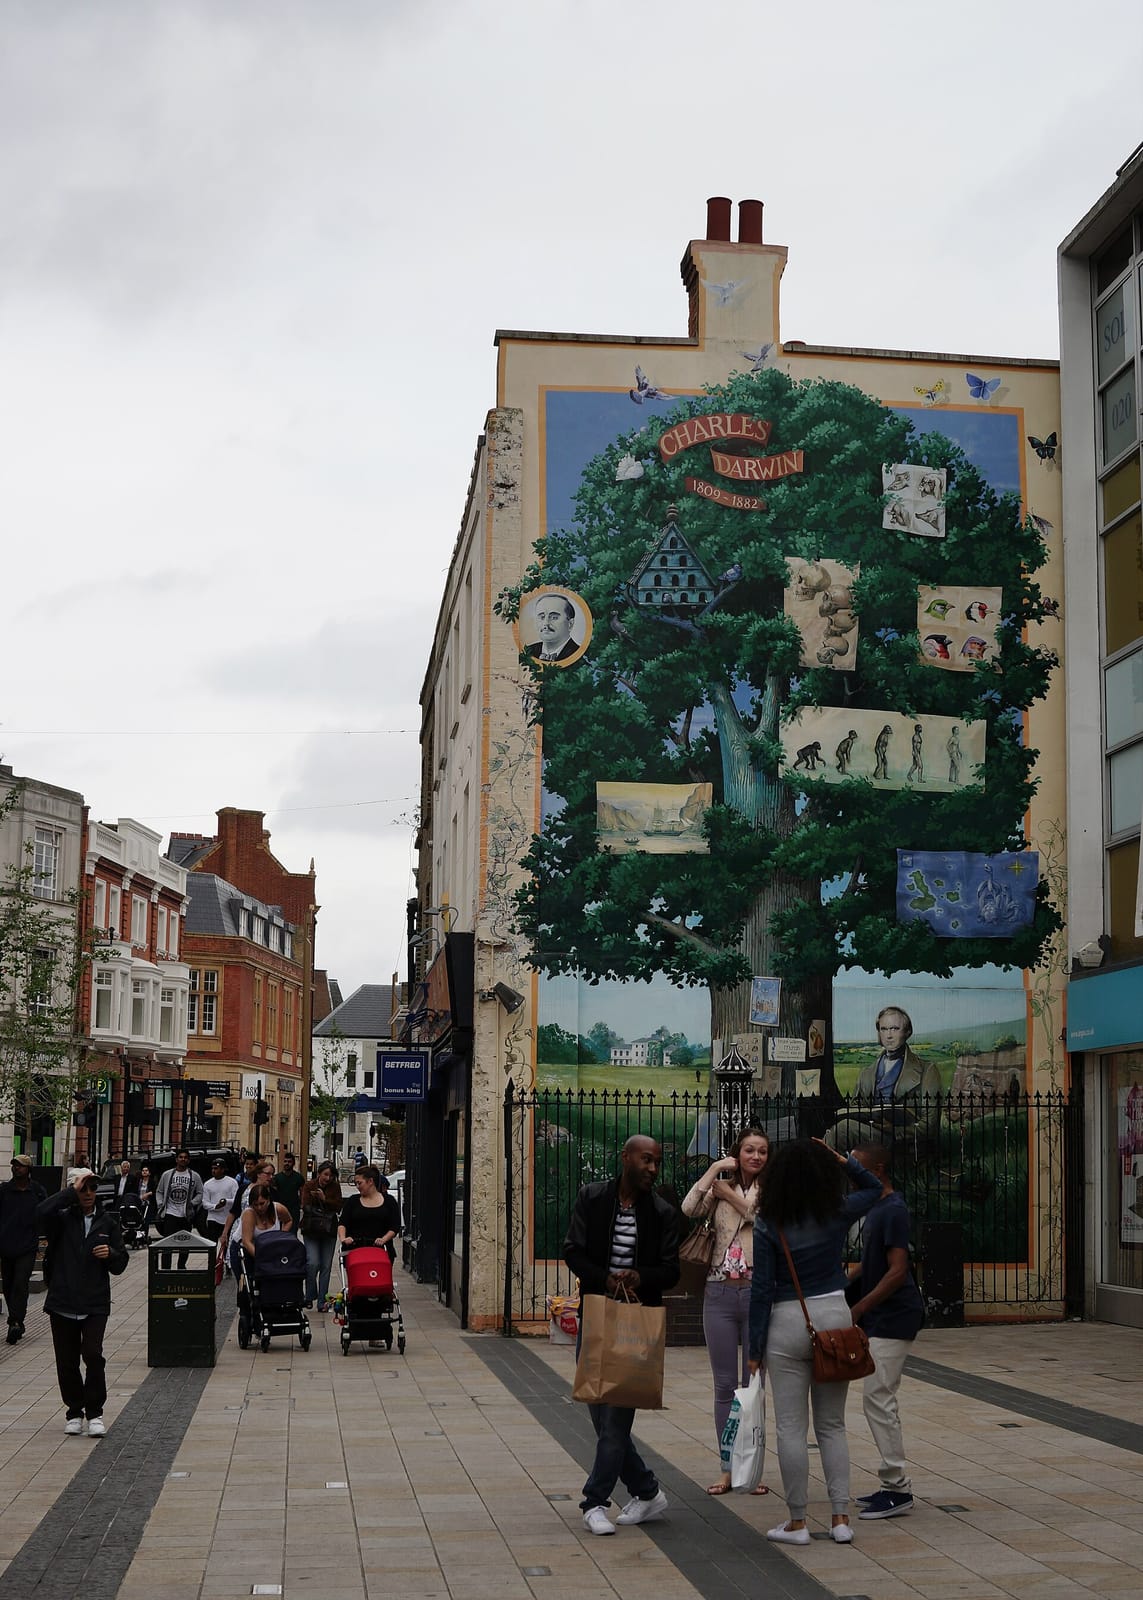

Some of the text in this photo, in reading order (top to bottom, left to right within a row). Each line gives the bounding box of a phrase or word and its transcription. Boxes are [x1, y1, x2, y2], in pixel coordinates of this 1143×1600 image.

[660, 415, 769, 456] CHARLES
[715, 451, 798, 480] DARWIN
[693, 480, 721, 500] 1809
[732, 496, 758, 509] 1882
[384, 1061, 421, 1069] BETFRED
[406, 1087, 421, 1095] king
